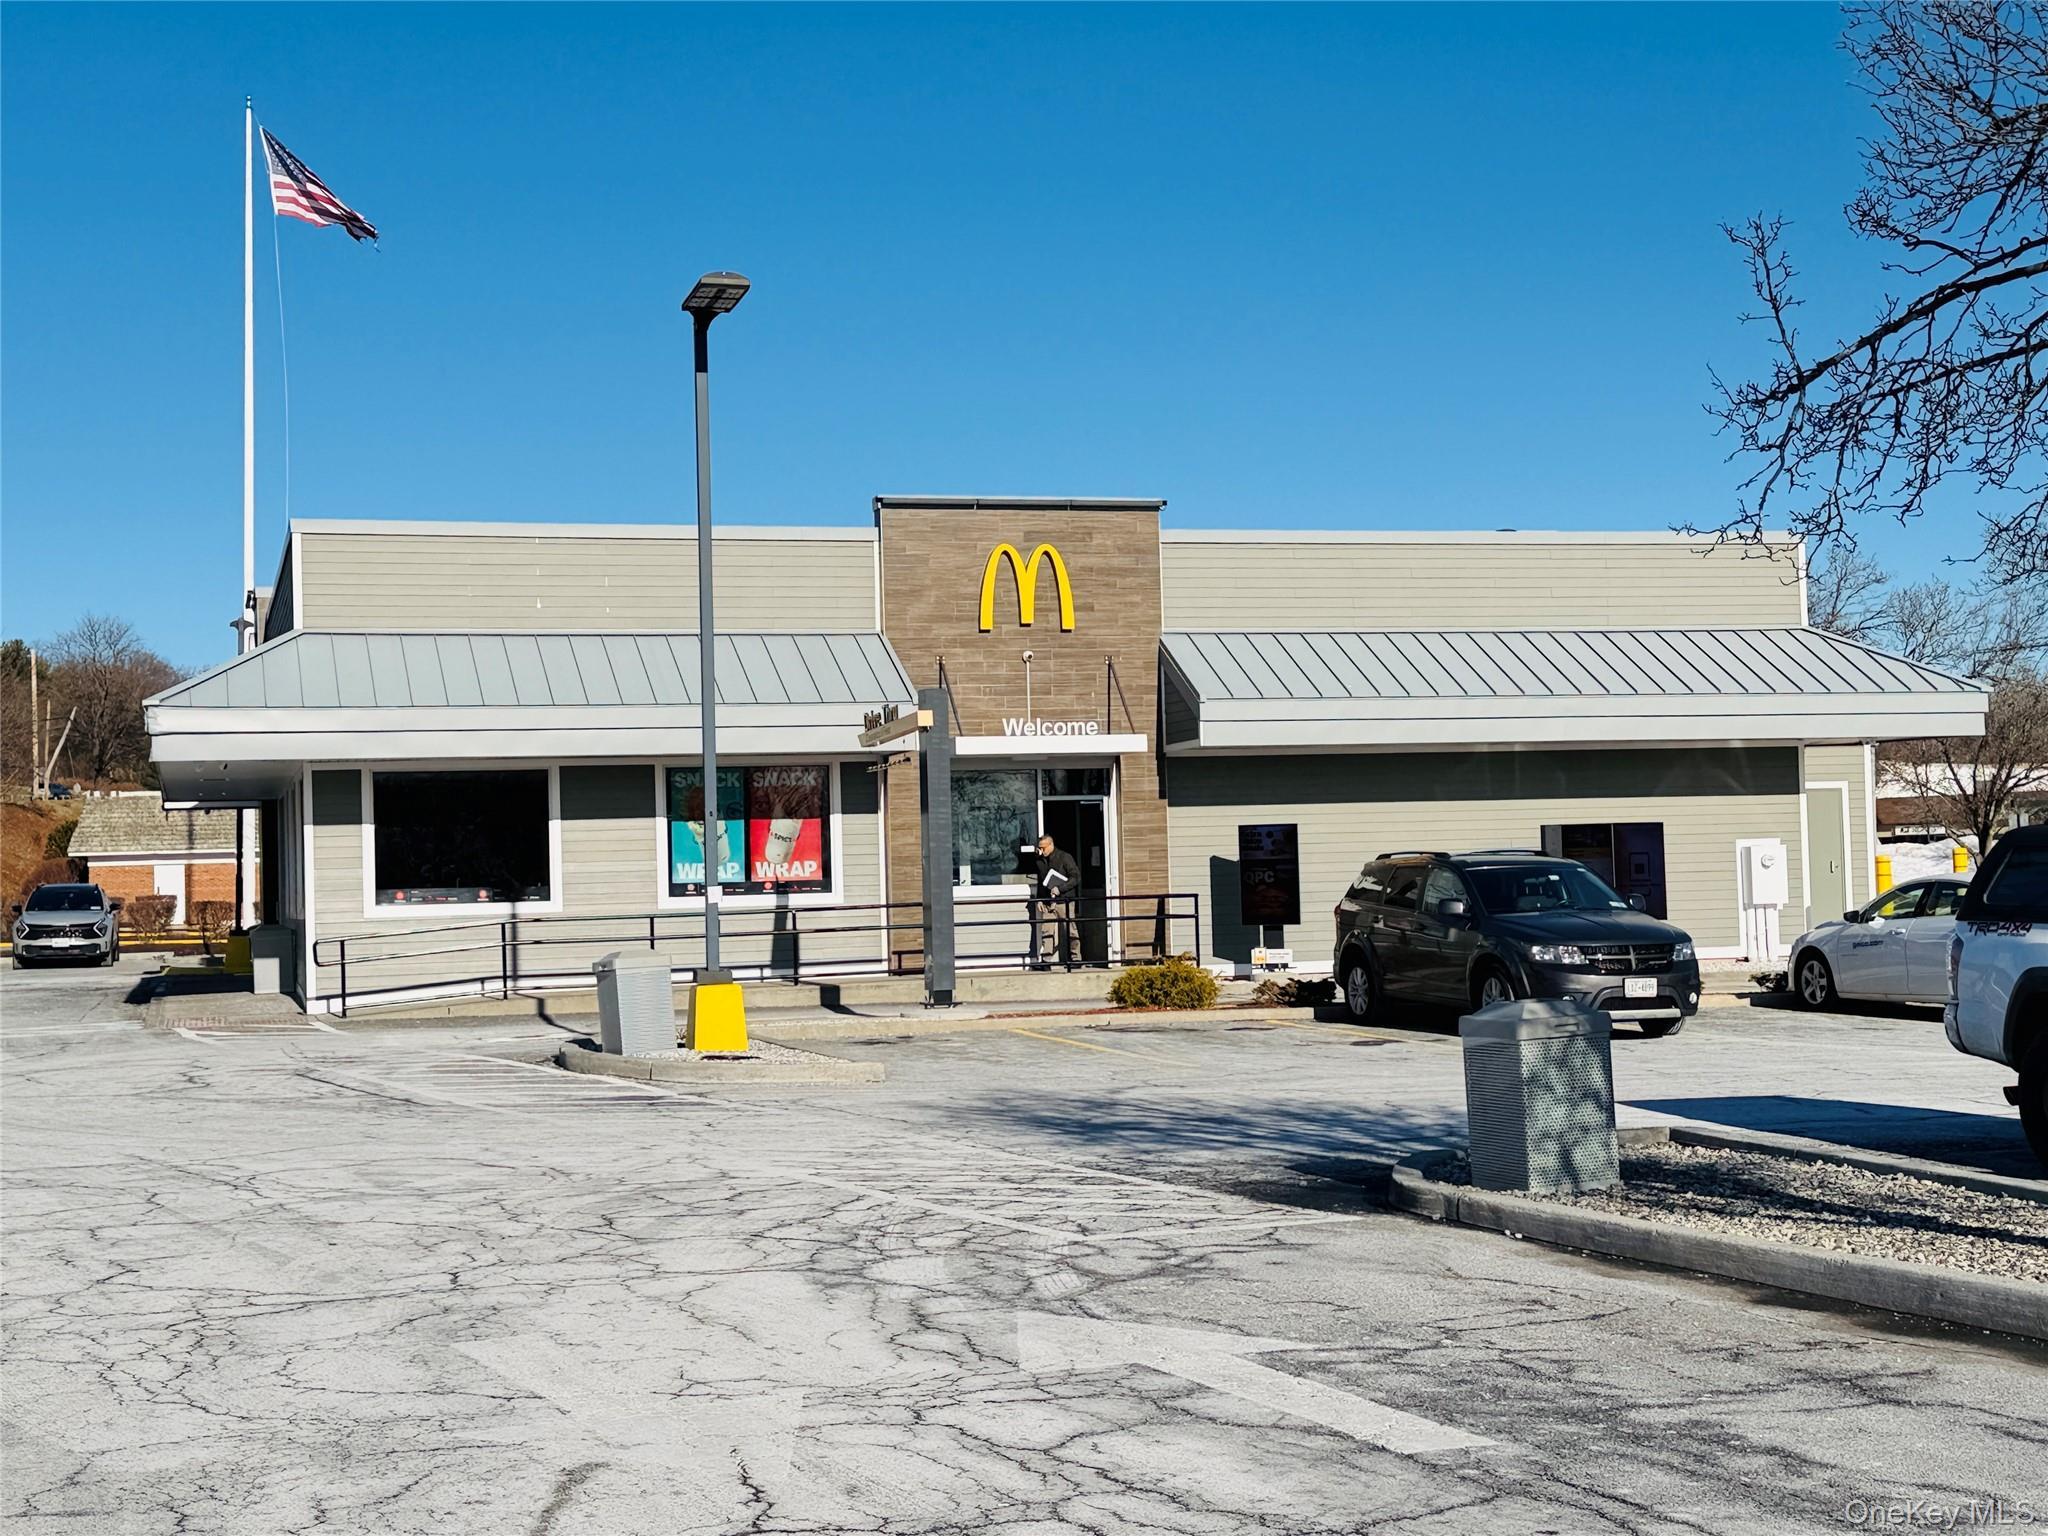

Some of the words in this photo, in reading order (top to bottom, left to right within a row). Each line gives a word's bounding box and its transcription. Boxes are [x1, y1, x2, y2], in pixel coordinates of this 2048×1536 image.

[1002, 718, 1099, 736] Welcome
[675, 772, 740, 788] SNCK
[752, 771, 817, 787] SNACK
[755, 861, 817, 878] WRAP
[1245, 871, 1275, 884] QPC
